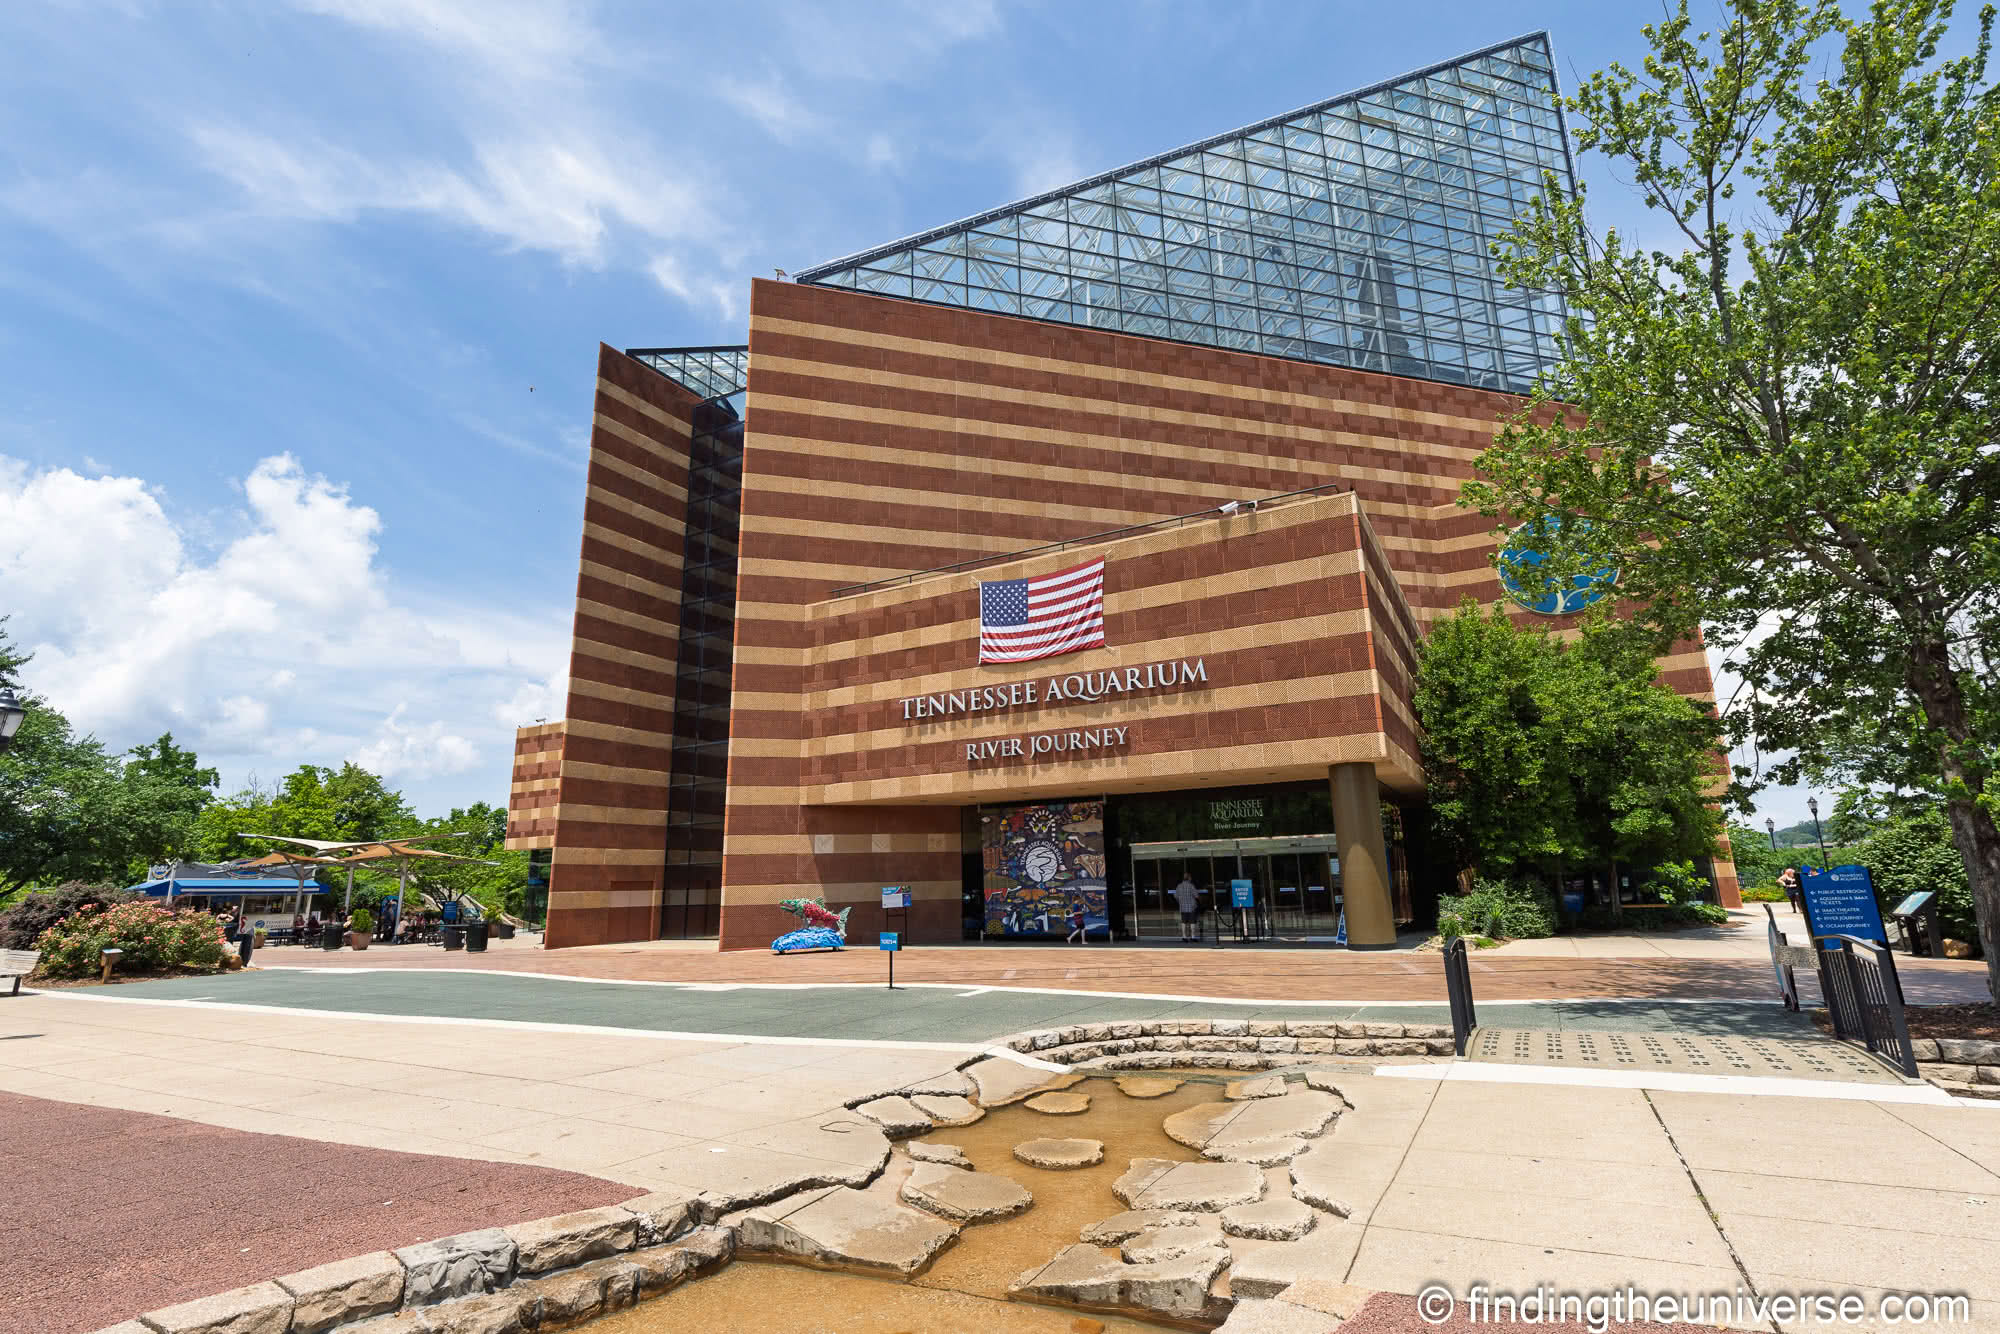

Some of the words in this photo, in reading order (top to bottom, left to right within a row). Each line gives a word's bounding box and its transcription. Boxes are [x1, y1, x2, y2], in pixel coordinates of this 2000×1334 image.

[899, 681, 1038, 720] TENNESSEE
[1044, 658, 1209, 701] AQUARIUM
[966, 739, 1024, 761] RIVER
[1029, 726, 1129, 758] JOURNEY
[1208, 799, 1263, 810] TENNESSEE
[1209, 808, 1264, 821] AQUARIUM
[1214, 822, 1231, 830] River
